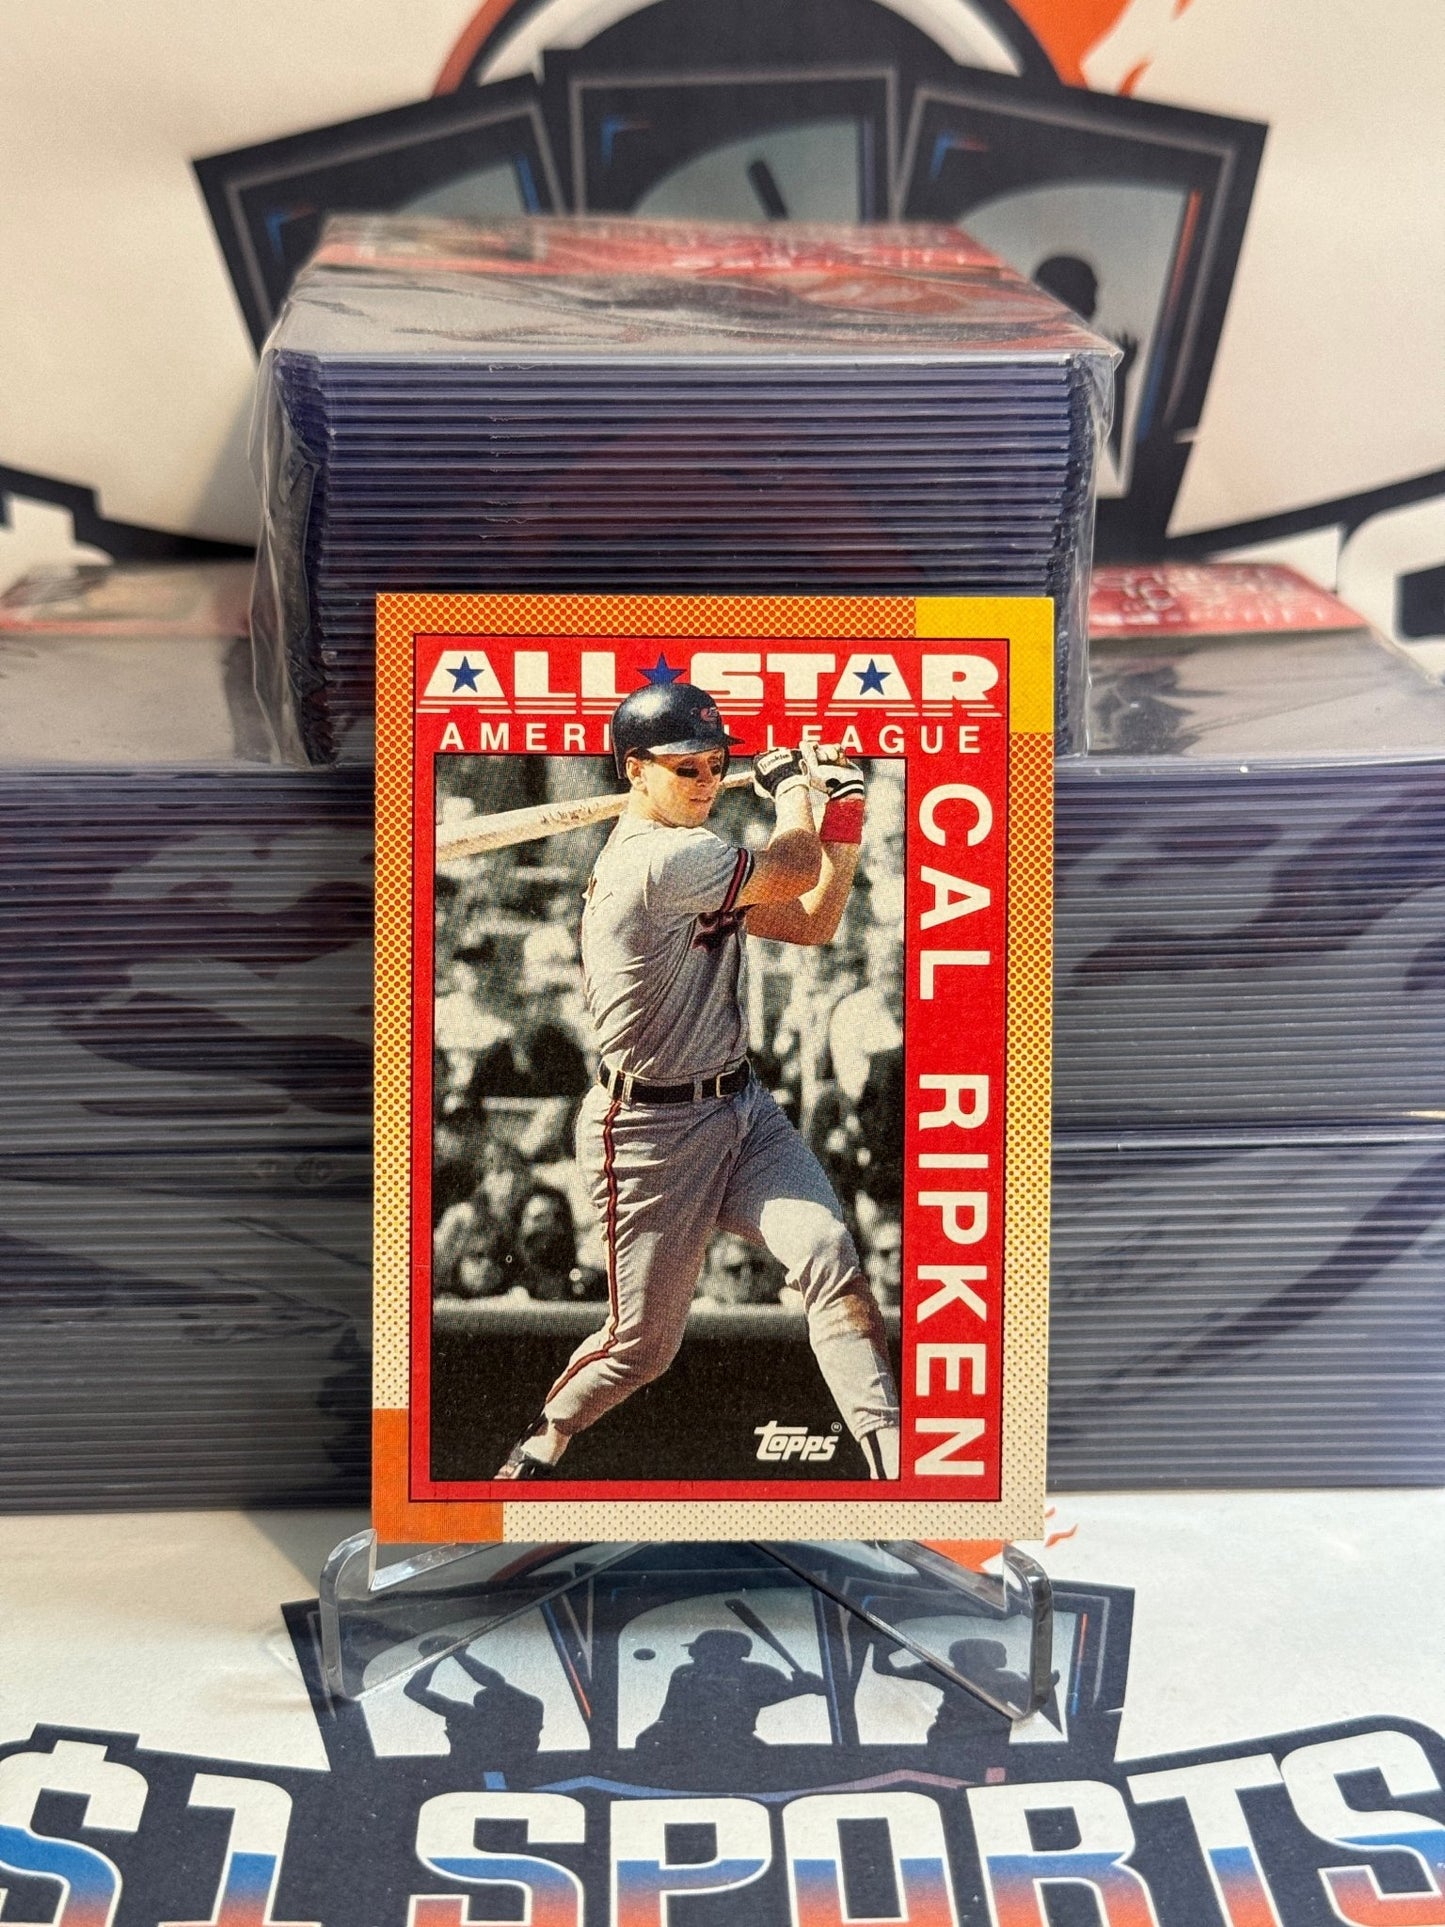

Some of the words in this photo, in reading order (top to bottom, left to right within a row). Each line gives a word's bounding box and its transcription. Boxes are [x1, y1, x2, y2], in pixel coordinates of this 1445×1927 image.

[416, 650, 627, 714] ALL
[689, 652, 1003, 717] STAR
[440, 722, 730, 751] AMERI
[918, 783, 994, 1001] CAL
[914, 1073, 990, 1476] RIPKEN
[405, 1729, 1445, 1927] SPORTS
